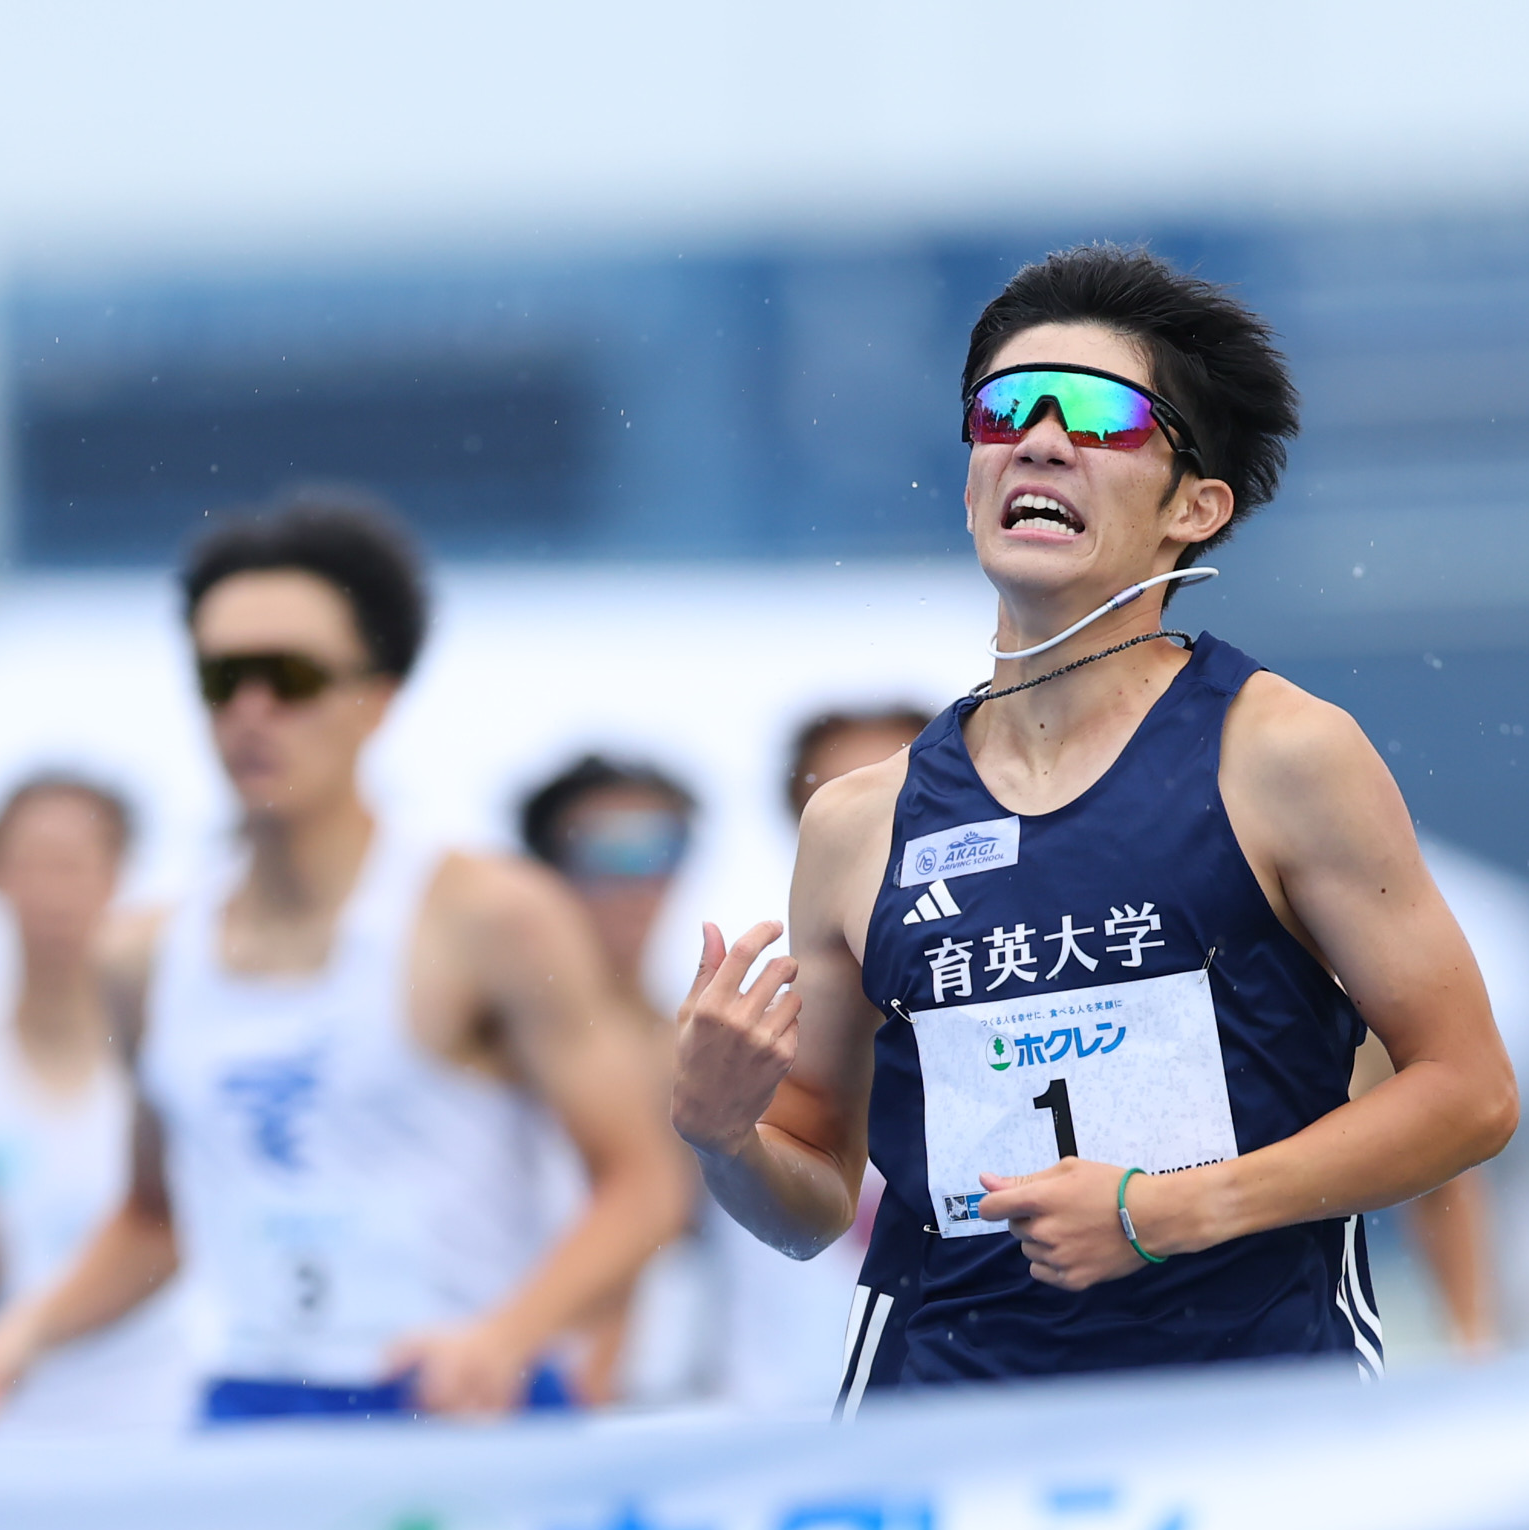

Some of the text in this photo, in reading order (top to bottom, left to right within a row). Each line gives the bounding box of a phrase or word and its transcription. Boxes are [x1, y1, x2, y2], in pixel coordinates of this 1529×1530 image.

[938, 853, 1005, 872] DRIVING SCHOOL
[944, 842, 996, 864] AKAGI
[923, 902, 1166, 1004] 育英大学
[1013, 1022, 1127, 1068] ホクレン
[1032, 1078, 1079, 1161] 1
